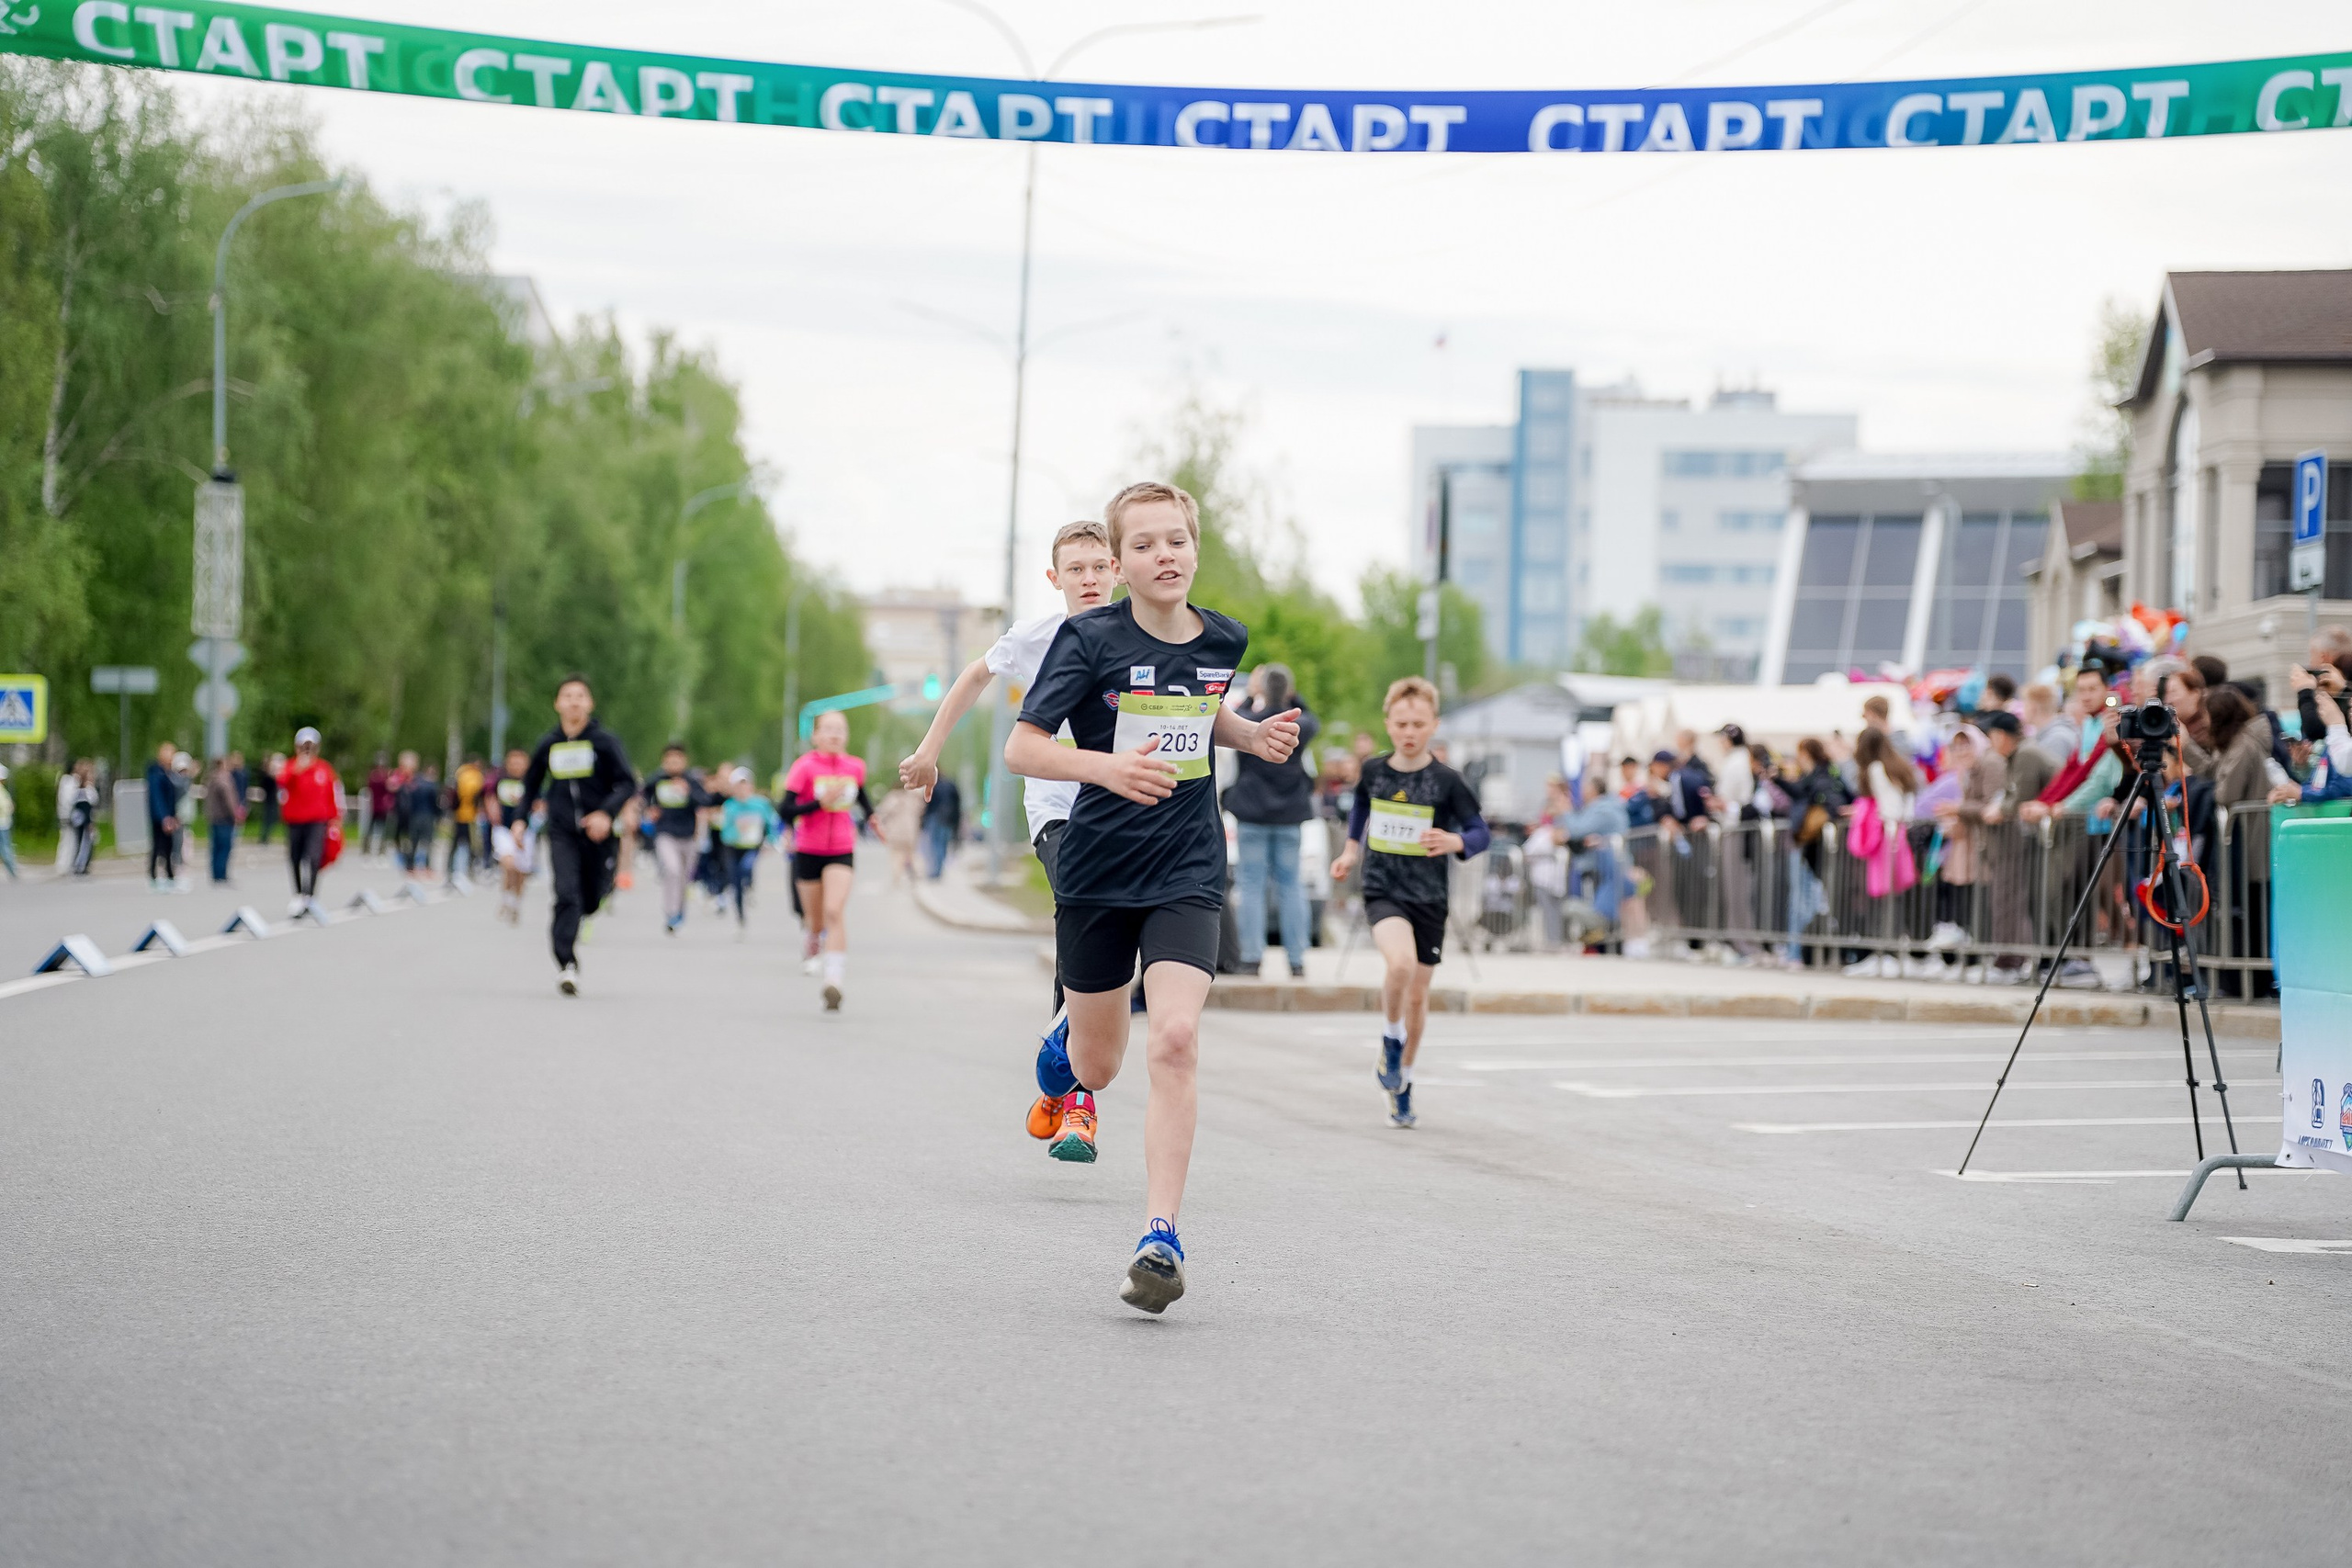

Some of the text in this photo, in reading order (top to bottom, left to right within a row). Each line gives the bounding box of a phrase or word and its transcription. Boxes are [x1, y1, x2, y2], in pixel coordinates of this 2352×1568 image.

[72, 0, 384, 89] СТАРТ
[453, 48, 753, 123] СТАРТ
[819, 82, 1114, 144] СТАРТ
[1174, 100, 1467, 152] СТАРТ
[1528, 98, 1824, 152] СТАРТ
[1885, 80, 2189, 147] СТАРТ
[2301, 462, 2321, 537] P
